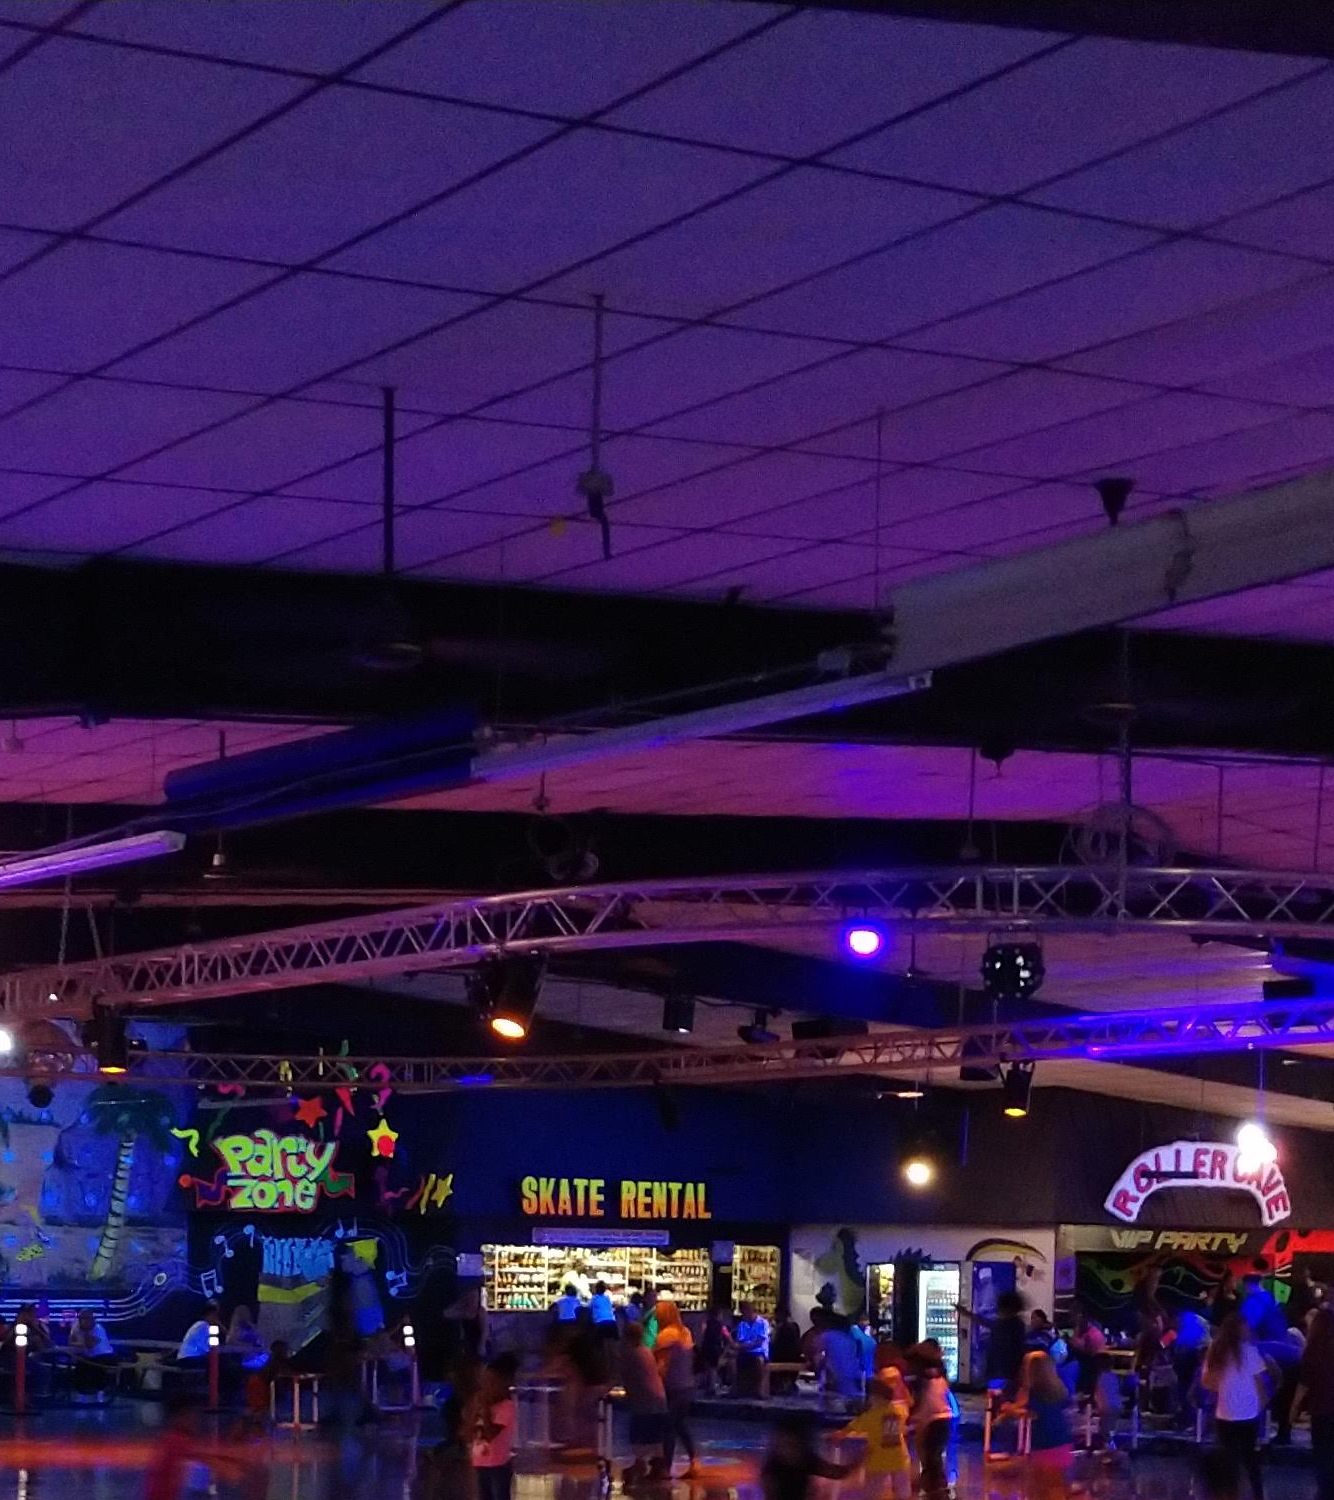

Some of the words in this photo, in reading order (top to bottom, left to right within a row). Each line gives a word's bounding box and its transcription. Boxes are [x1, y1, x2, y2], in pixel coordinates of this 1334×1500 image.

[521, 1176, 605, 1216] SKATE
[620, 1180, 712, 1219] RENTAL
[1113, 1148, 1228, 1218] ROLLER
[1111, 1230, 1155, 1249] VIP
[1155, 1231, 1249, 1254] PARTY
